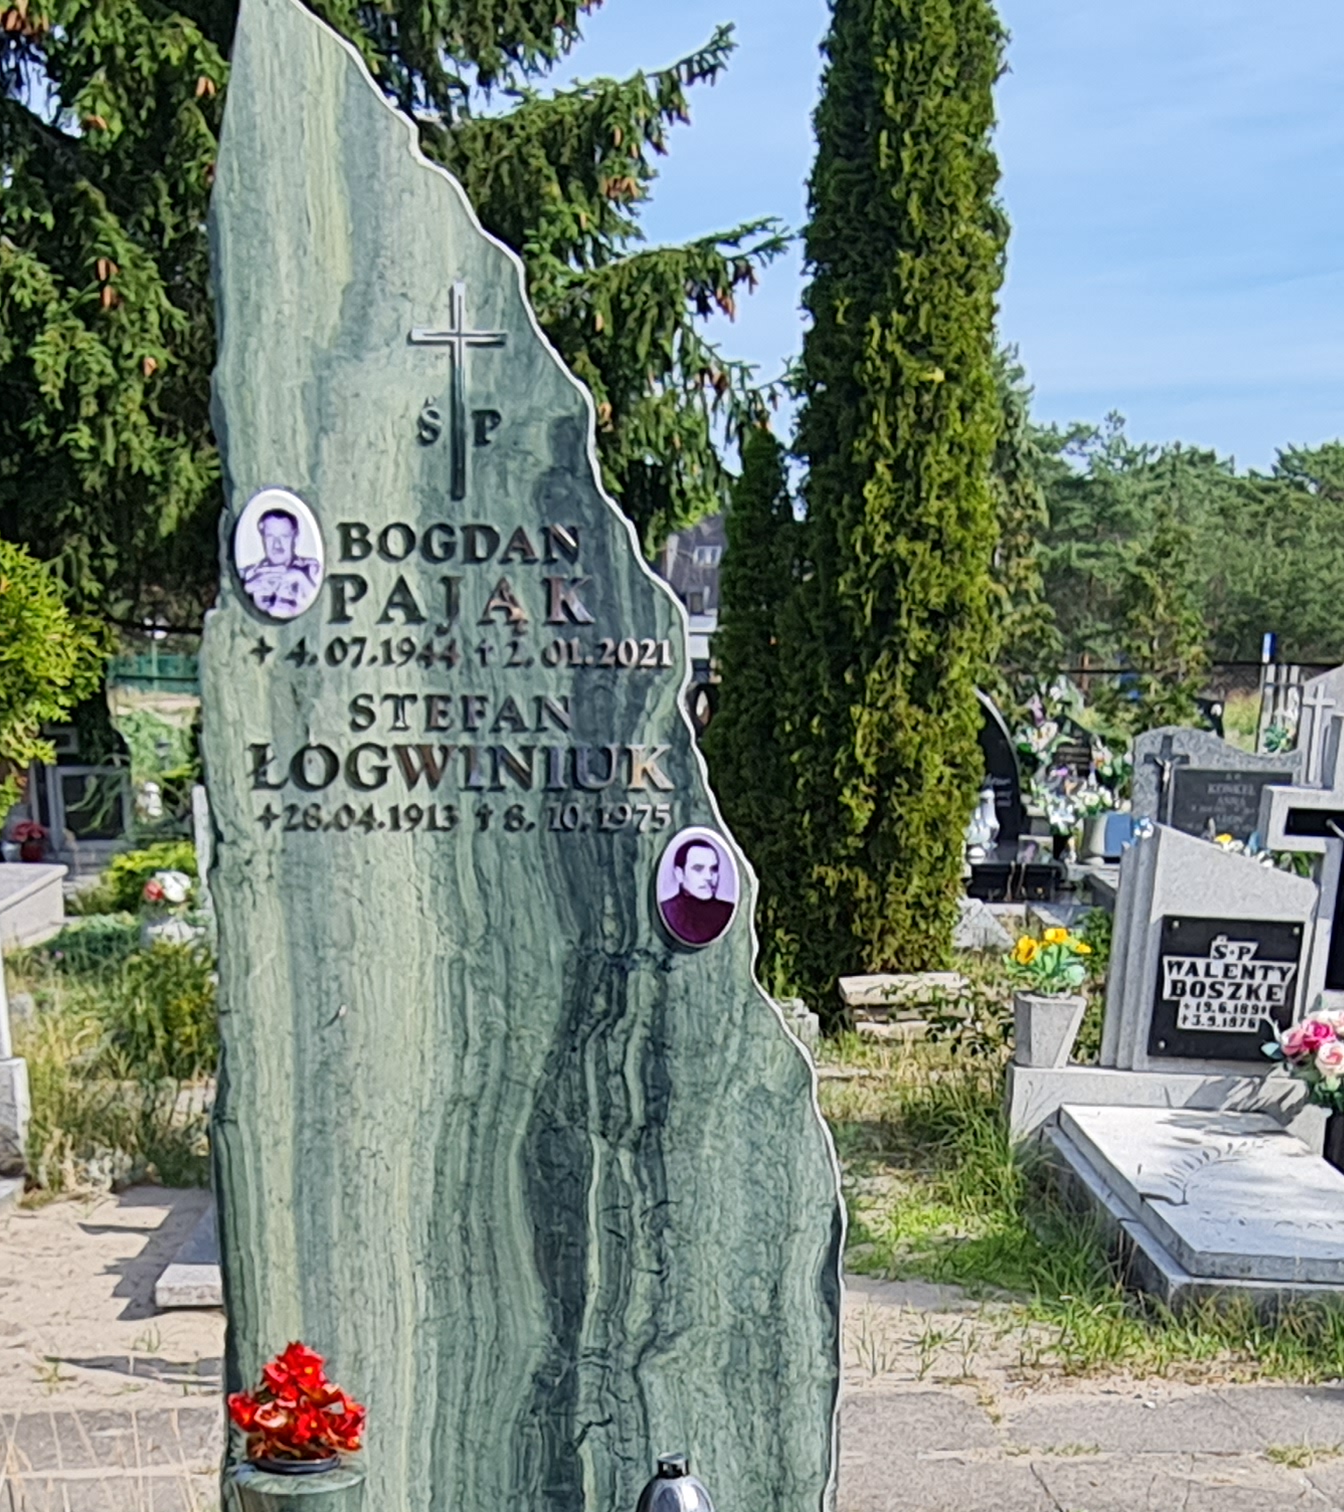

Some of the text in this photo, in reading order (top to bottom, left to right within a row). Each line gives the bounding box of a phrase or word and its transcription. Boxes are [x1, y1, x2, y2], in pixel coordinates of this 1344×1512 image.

[337, 521, 580, 564] BOGDAN
[327, 573, 596, 635] PAJĄK
[349, 693, 572, 733] STEFAN
[248, 741, 675, 792] ŁOGWINIUK
[1167, 960, 1293, 982] WALENTY
[1169, 979, 1284, 1002] BOSZKE
